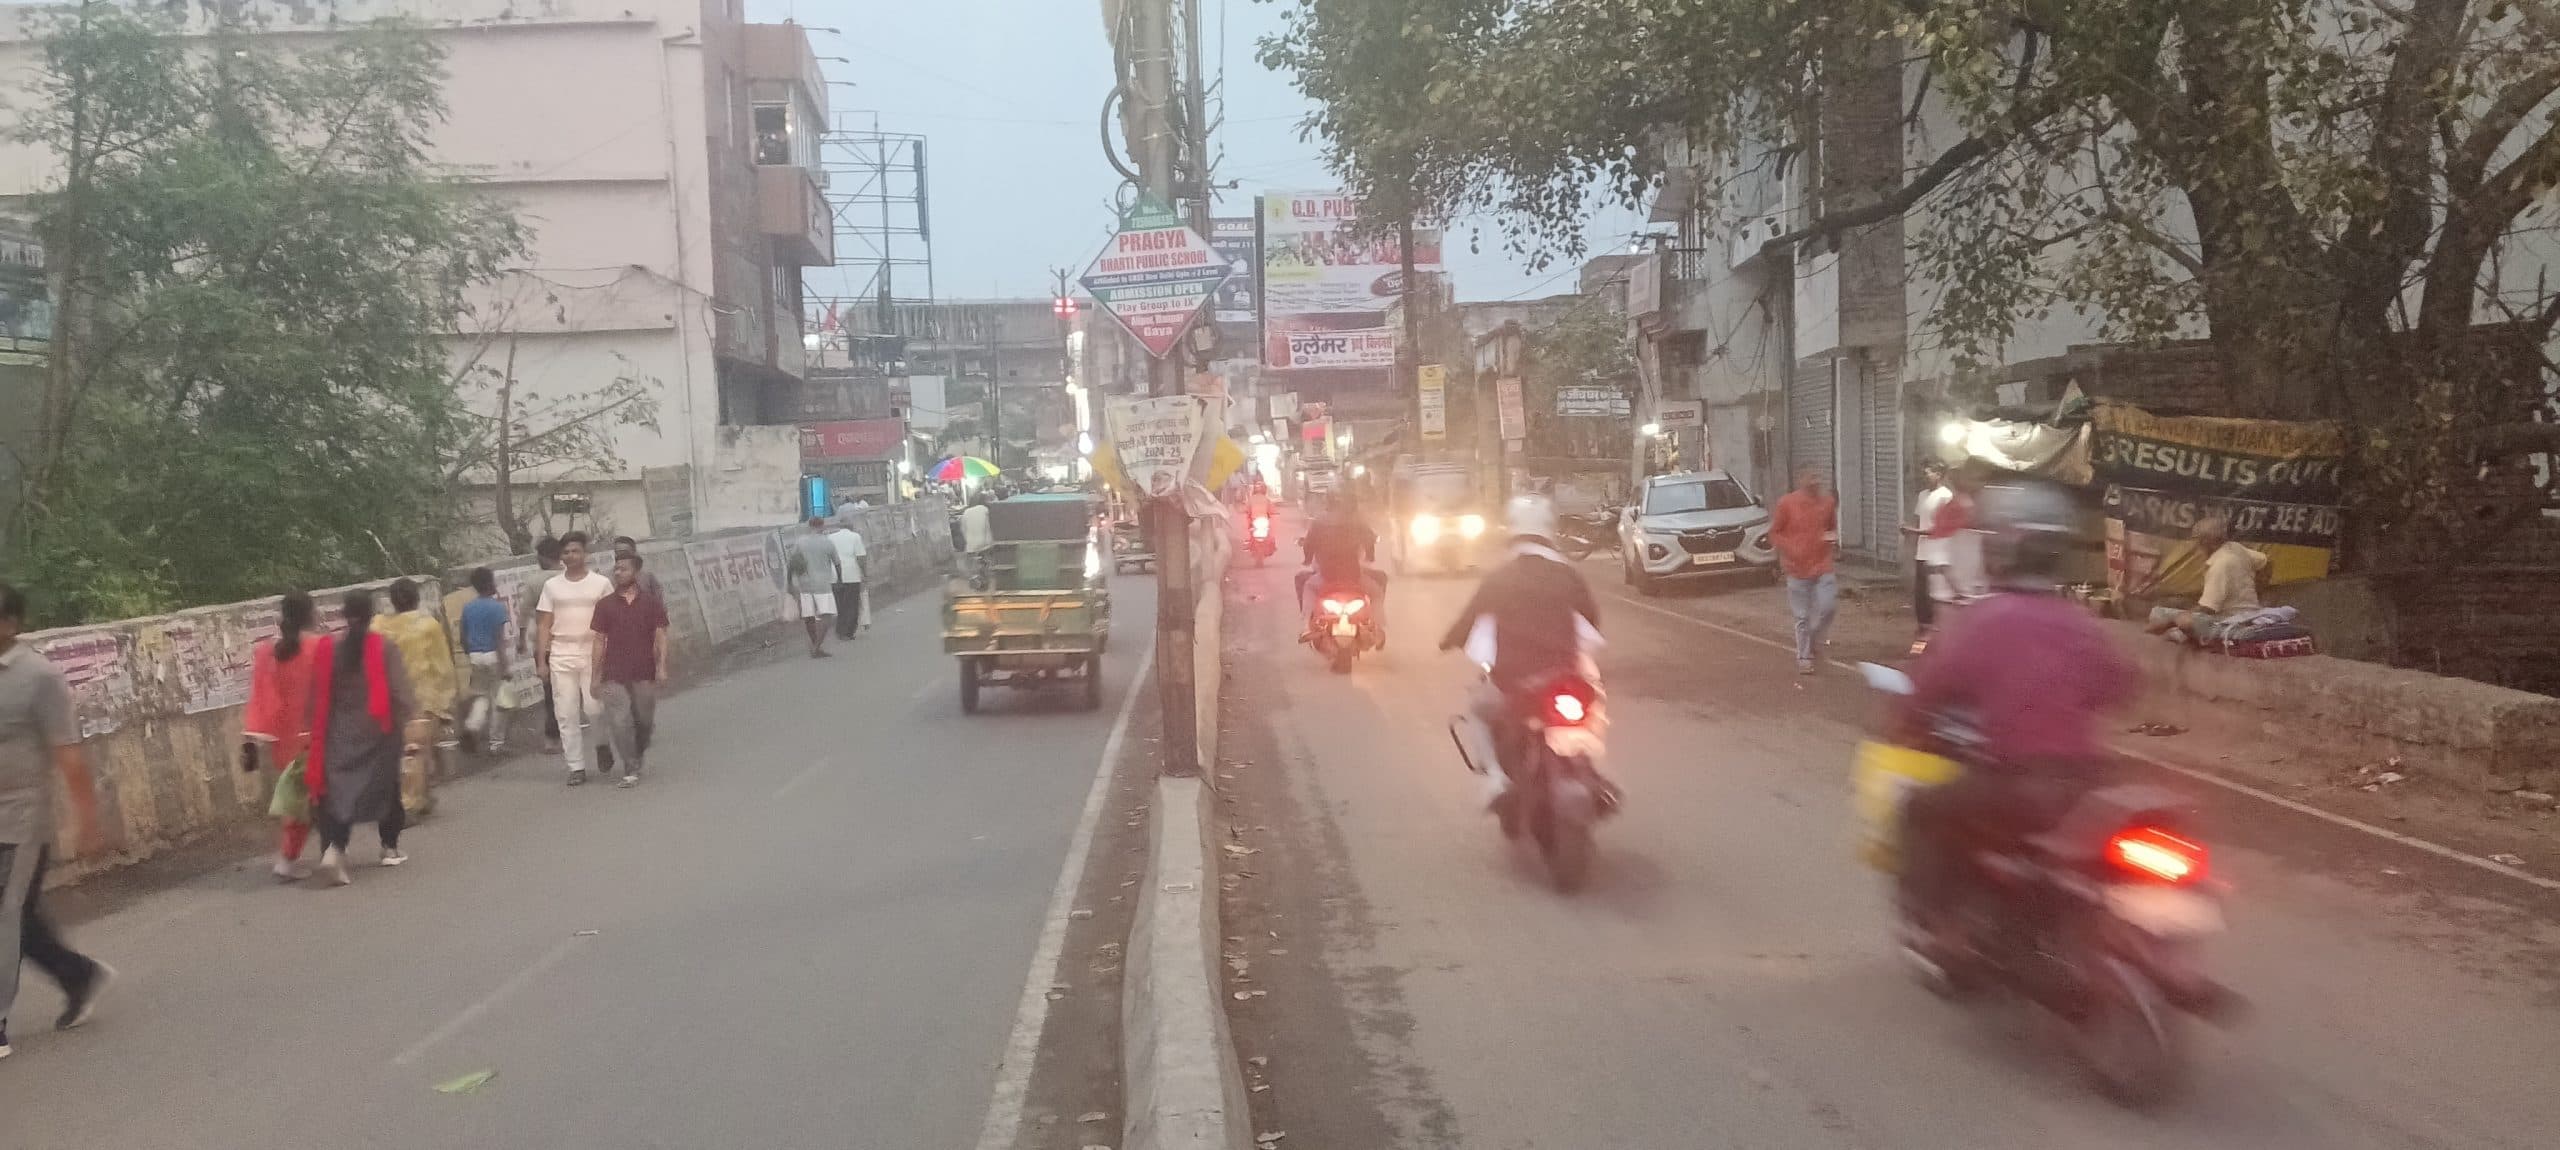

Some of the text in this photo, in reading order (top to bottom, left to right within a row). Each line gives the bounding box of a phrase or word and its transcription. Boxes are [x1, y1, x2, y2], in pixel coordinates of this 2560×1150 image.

[1119, 229, 1187, 253] PRAGYA
[1100, 250, 1209, 273] BHARTI PUBLIC SCHOOL
[1110, 281, 1203, 301] ADMISSION OPEN
[1117, 297, 1194, 312] Play Group to IX
[1143, 326, 1173, 337] Gaya
[2117, 439, 2257, 486] RESULTS
